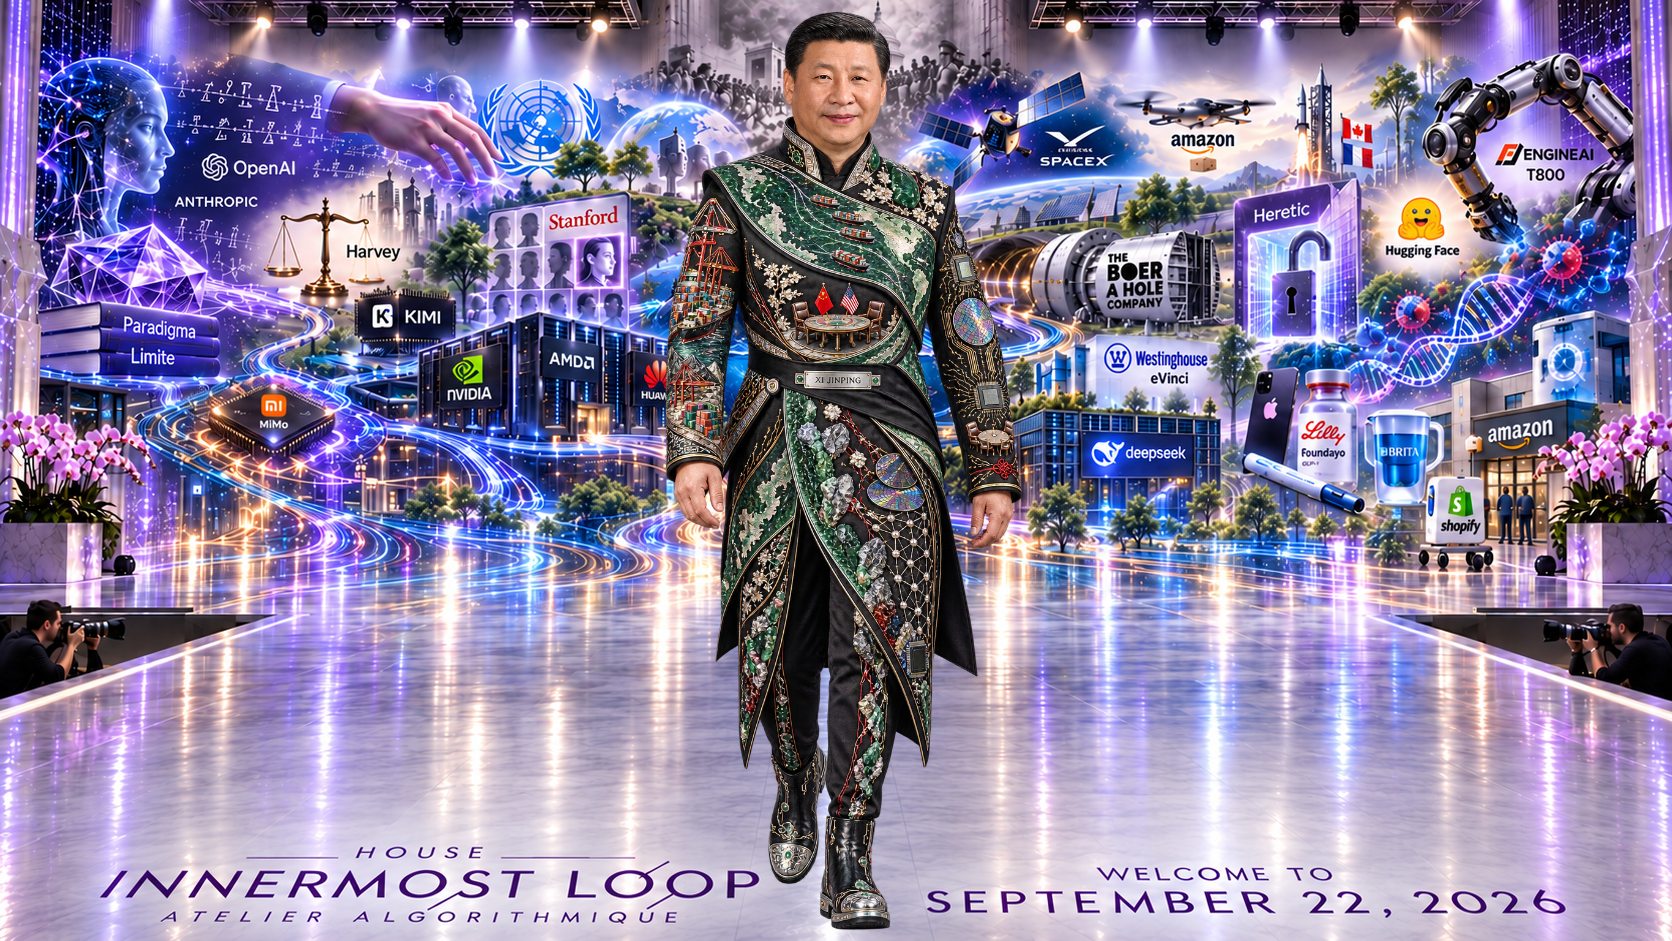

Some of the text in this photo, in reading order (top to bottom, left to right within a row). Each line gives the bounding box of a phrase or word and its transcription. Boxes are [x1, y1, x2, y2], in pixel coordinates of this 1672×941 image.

[1171, 134, 1235, 148] amazon
[1040, 153, 1115, 167] SPACEX
[1523, 148, 1594, 161] ENGINEAI
[233, 159, 296, 179] OpenAI
[1526, 168, 1565, 181] T800
[174, 195, 258, 208] ANTHROPIC
[549, 205, 618, 230] Stanford
[1253, 202, 1310, 223] Heretic
[346, 243, 401, 262] Harvey
[1107, 252, 1128, 263] THE
[1385, 244, 1460, 258] Hugging Face
[1106, 281, 1164, 298] A HOLE
[1107, 297, 1163, 310] COMPANY
[405, 309, 441, 325] KIMI
[123, 316, 196, 341] Paradigma
[131, 347, 175, 366] Limite
[549, 352, 584, 369] AMD
[1135, 350, 1208, 369] Westinghouse
[815, 376, 862, 384] XI JINPING
[1150, 372, 1189, 384] eVinci
[641, 391, 667, 400] HUAW
[259, 420, 289, 429] MiMo
[1487, 418, 1554, 443] amazon
[1301, 420, 1346, 446] Lilly
[1125, 446, 1187, 461] deepseek
[1301, 448, 1346, 460] Foundayo
[1389, 446, 1419, 457] BRITA
[1440, 519, 1481, 535] shopify
[355, 846, 484, 860] HOUSE
[1096, 866, 1333, 881] WELCOME TO
[99, 868, 760, 899] INNERMOST LOOP
[926, 889, 1566, 918] SEPTEMBER 22, 2026
[160, 910, 678, 924] ATELIER ALGORITHMIQUE
